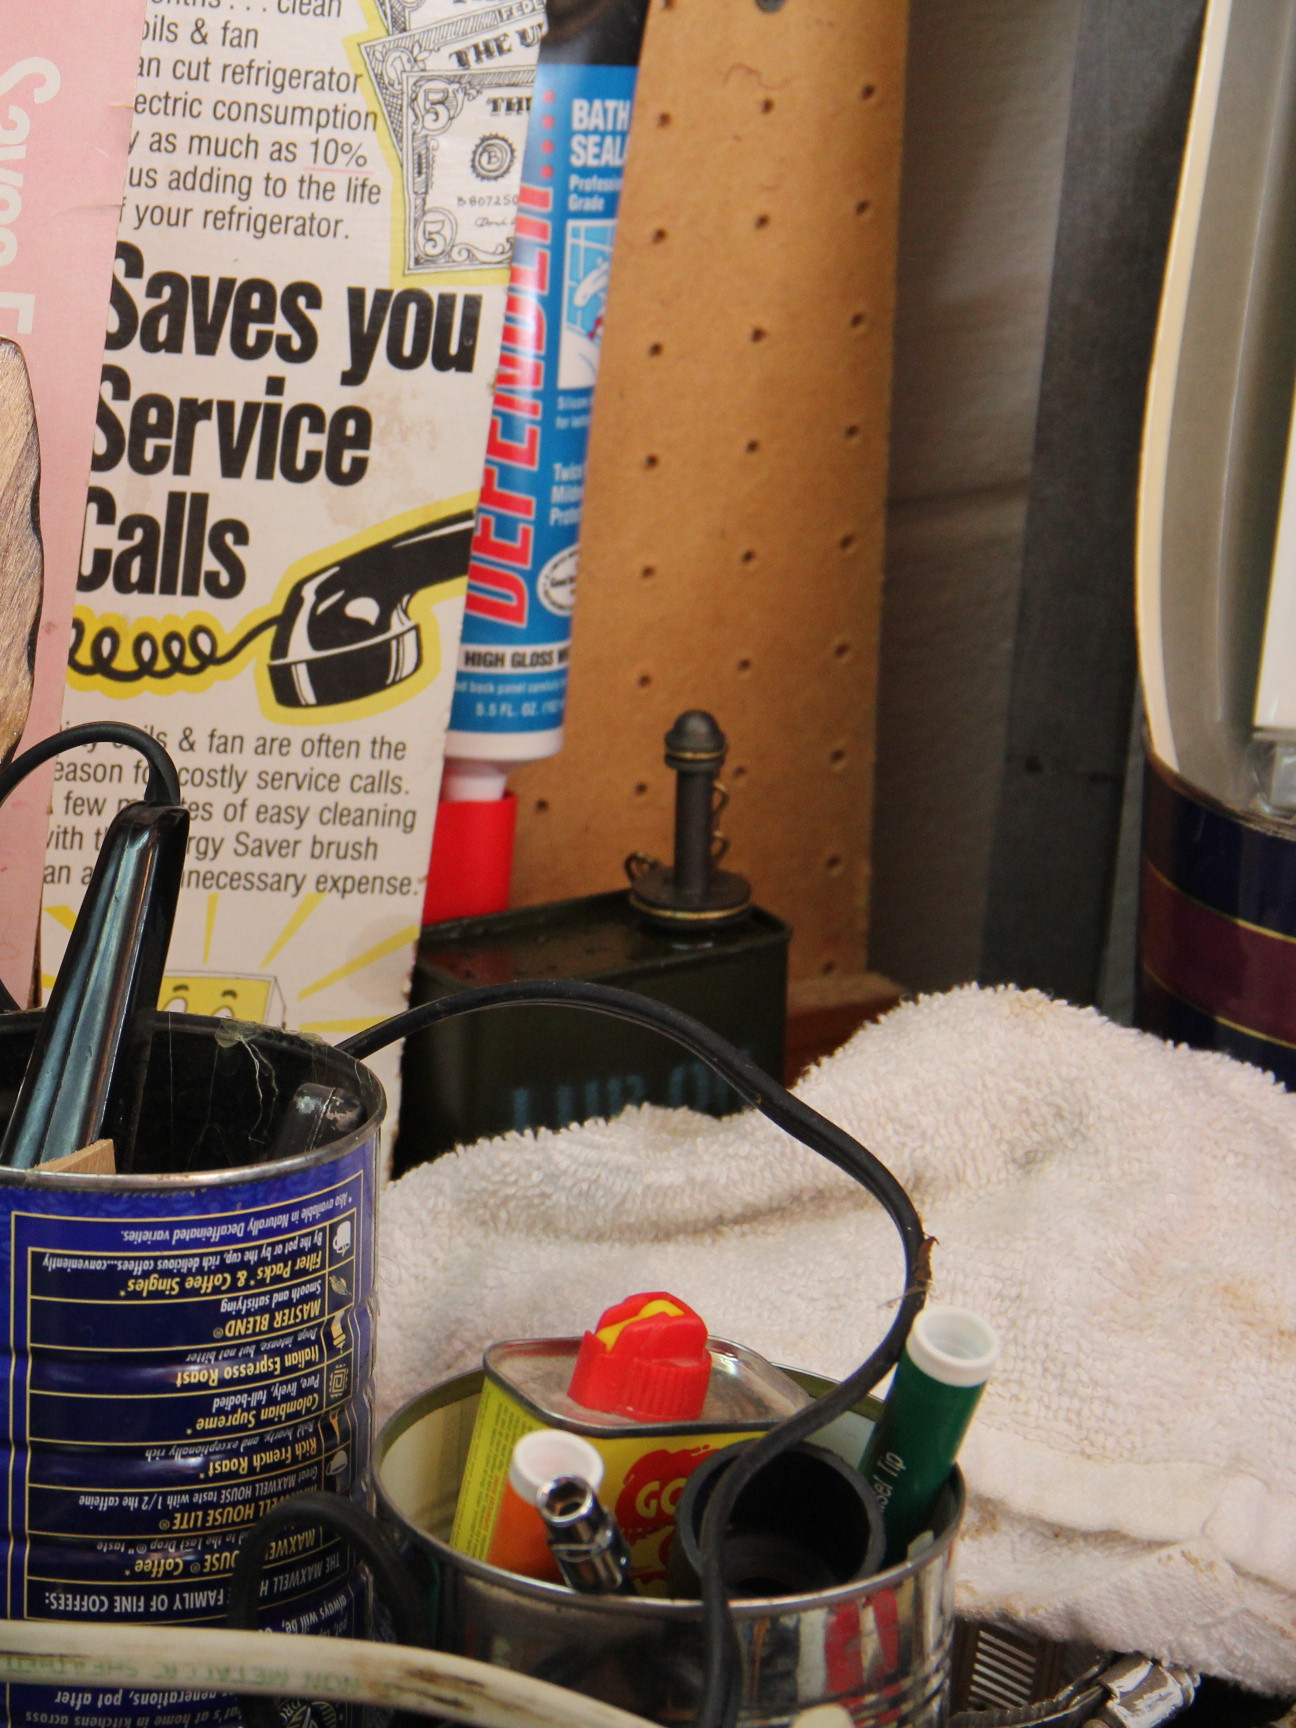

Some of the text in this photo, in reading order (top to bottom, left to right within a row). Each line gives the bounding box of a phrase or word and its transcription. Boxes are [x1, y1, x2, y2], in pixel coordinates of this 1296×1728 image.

[220, 20, 259, 49] fan
[449, 33, 513, 69] THE
[172, 57, 211, 82] cut
[221, 58, 363, 94] refrigerator
[134, 91, 378, 134] ectric consumption
[572, 98, 630, 131] BATH
[149, 132, 368, 168] as much as 10%
[129, 165, 381, 205] us adding to the life
[133, 203, 349, 240] your refrigerator.
[104, 240, 483, 386] Saves you
[91, 363, 372, 487] Service
[76, 486, 250, 600] Calls
[464, 650, 554, 668] HIGH GLOSS
[207, 728, 408, 761] fan are often the
[178, 764, 410, 796] costly service calls.
[64, 791, 107, 817] few
[223, 799, 248, 822] of
[256, 804, 308, 830] easy
[319, 803, 417, 834] cleaning
[234, 832, 379, 861] Saver brush
[315, 874, 420, 900] expense.
[172, 1222, 245, 1245] Decaffeinated
[202, 1248, 259, 1268] the rich
[185, 1272, 232, 1291] Coffee
[220, 1289, 290, 1312] and satisfying
[225, 1299, 321, 1337] MASTER BLEND
[224, 1346, 319, 1380] Italian Espresso
[195, 1393, 319, 1430] Colombian Supreme
[212, 1384, 268, 1411] full-bodied
[208, 1443, 292, 1478] French Roast
[78, 1492, 190, 1510] with the caffeine
[172, 1502, 255, 1529] HOUSE LITE
[134, 1557, 184, 1578] Coffee
[44, 1590, 225, 1612] FAMILY OF FINE COFFEES:
[98, 1689, 124, 1706] pot
